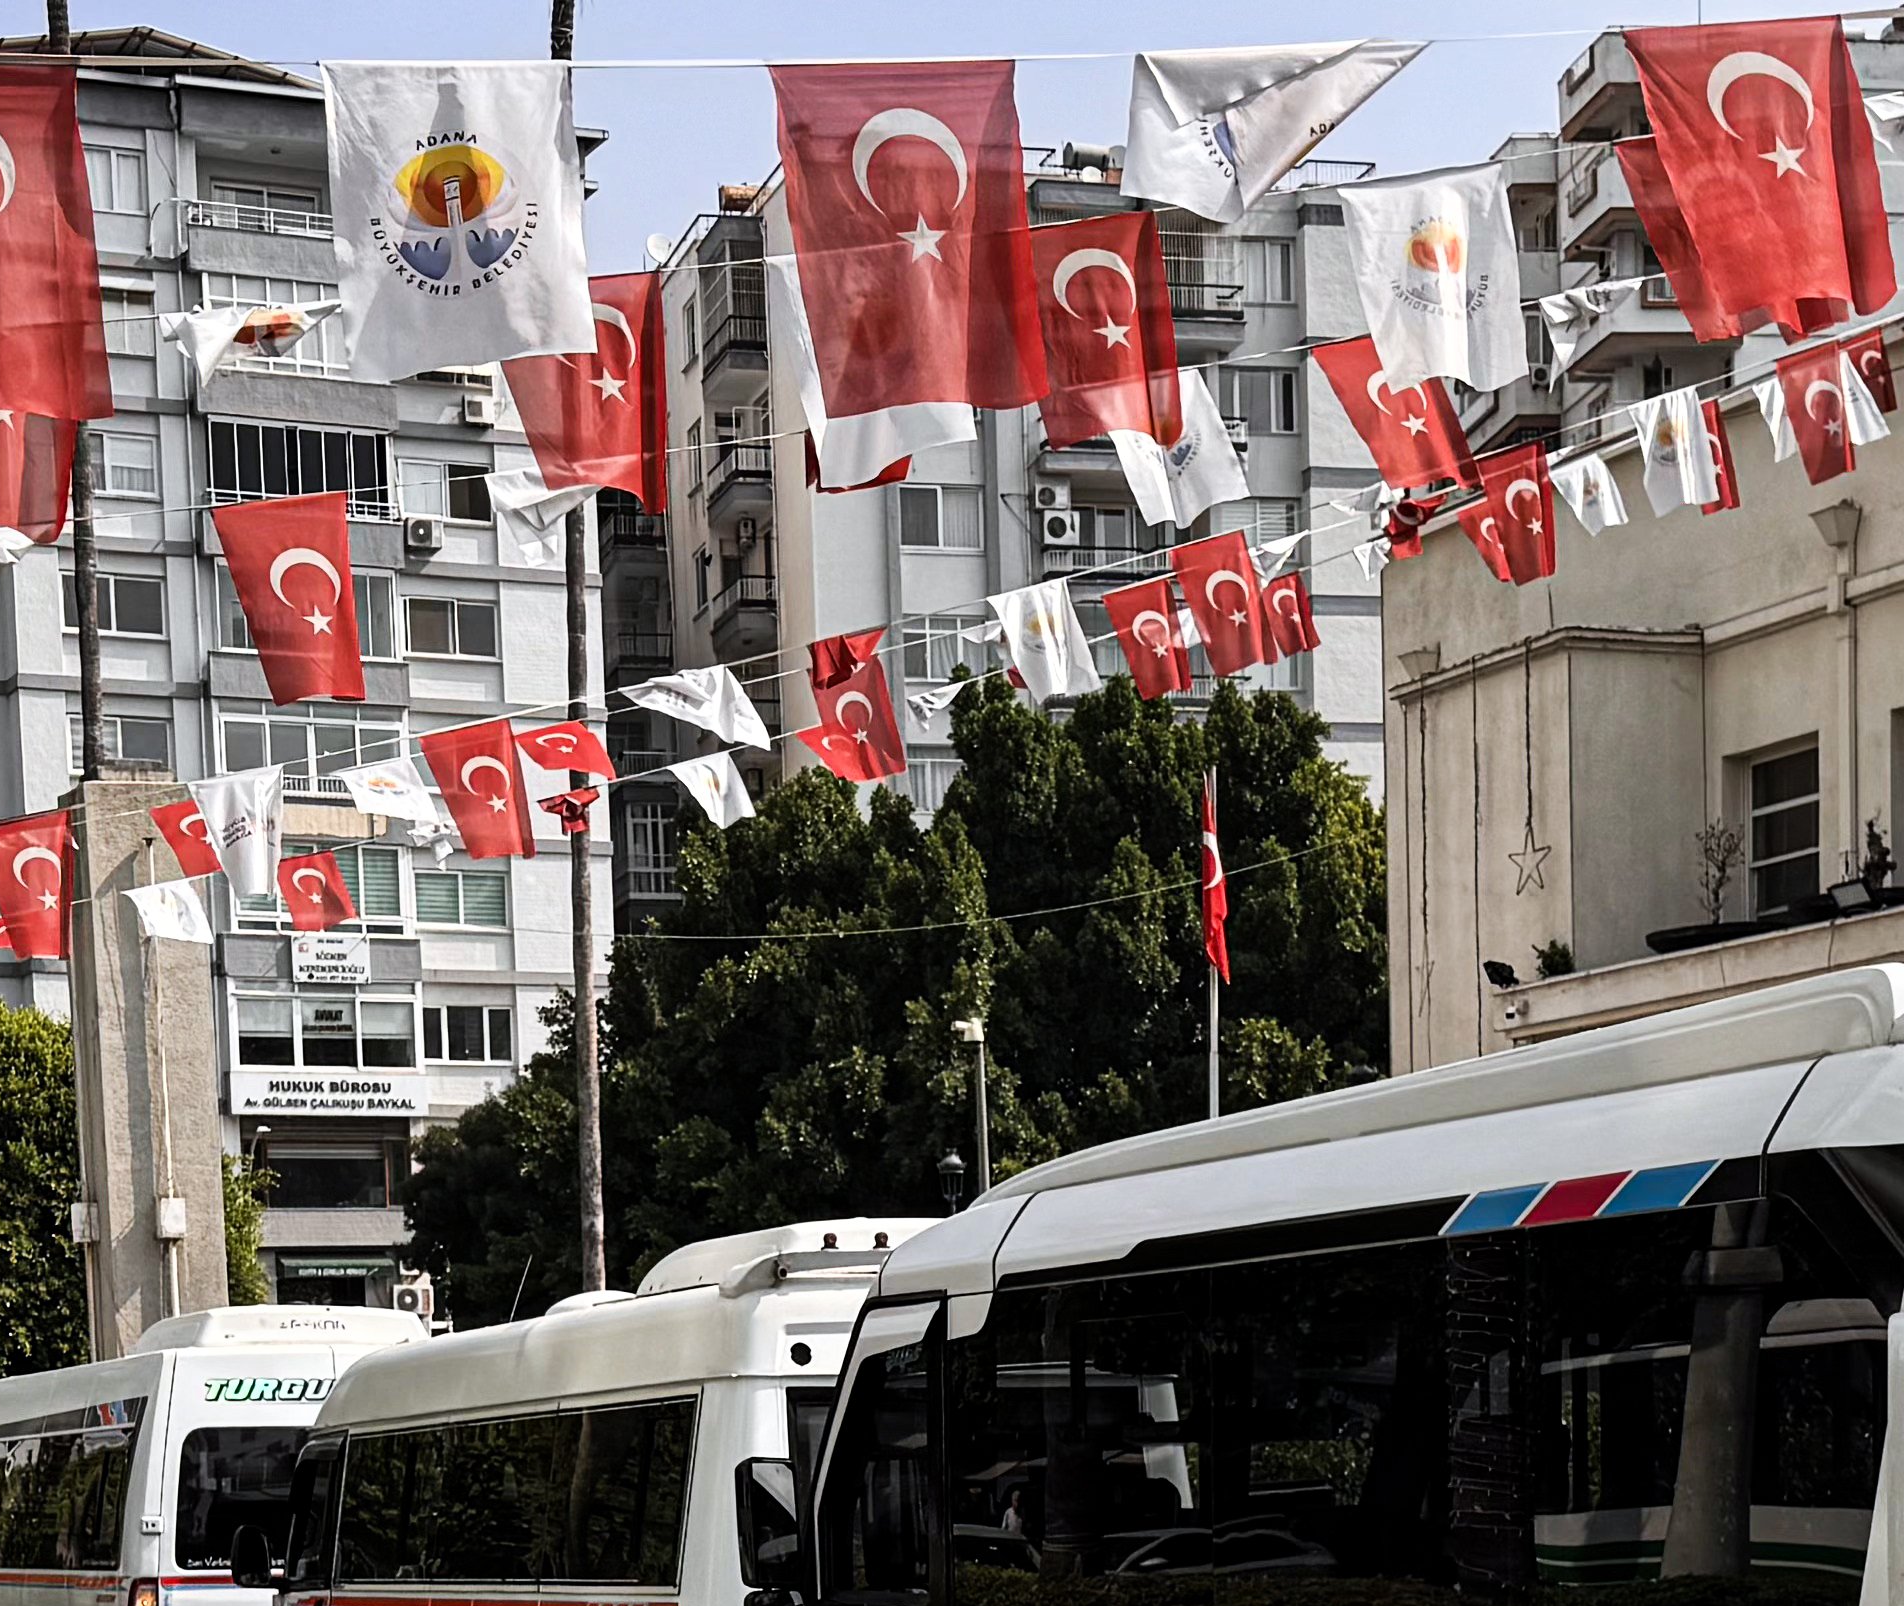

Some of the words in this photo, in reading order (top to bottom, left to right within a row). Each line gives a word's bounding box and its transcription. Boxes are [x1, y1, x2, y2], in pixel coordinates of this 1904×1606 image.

[416, 131, 478, 151] ADANA
[268, 1080, 325, 1093] HUKUK
[329, 1079, 392, 1094] BÜROSU
[367, 1098, 416, 1110] BAYKAL
